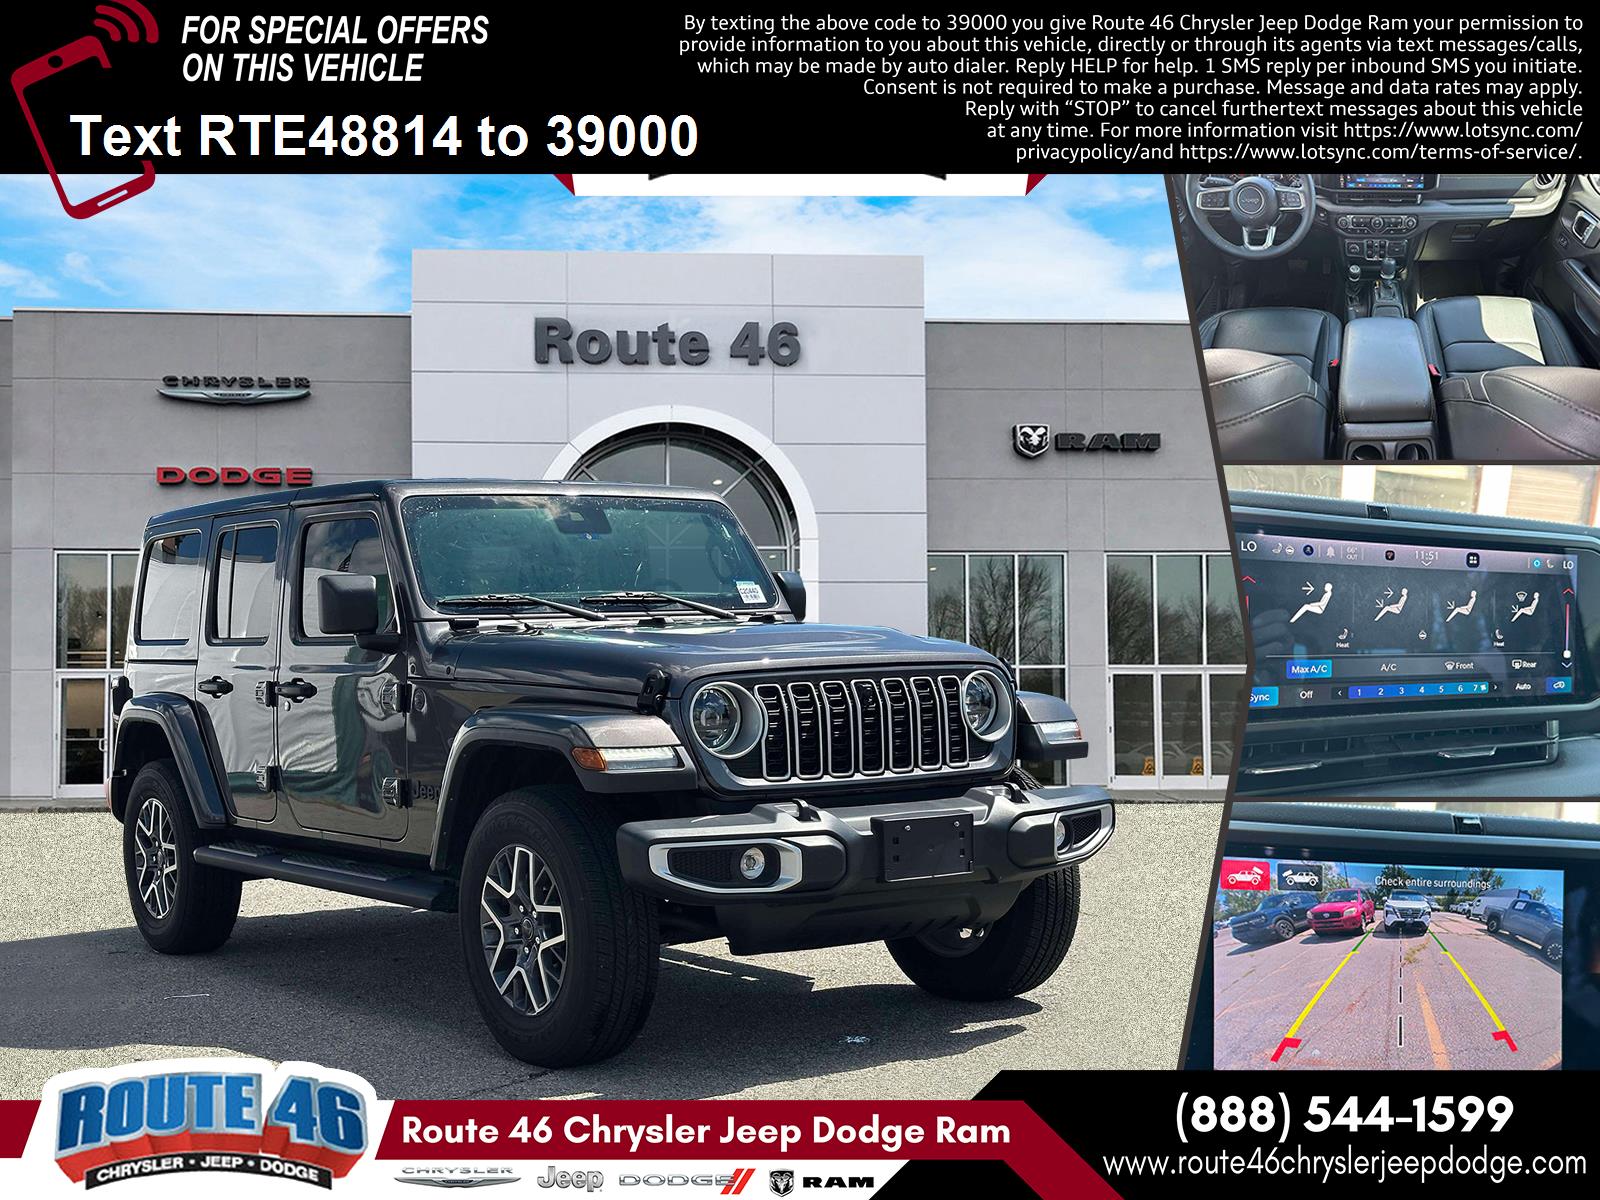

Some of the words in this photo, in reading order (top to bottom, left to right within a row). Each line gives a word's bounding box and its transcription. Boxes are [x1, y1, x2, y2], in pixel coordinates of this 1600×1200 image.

[534, 317, 711, 366] Route
[730, 322, 801, 367] 46
[162, 375, 311, 388] CHRYSLER
[1054, 432, 1162, 452] RAM
[156, 466, 313, 486] DODGE
[1241, 541, 1257, 552] LO
[1415, 550, 1439, 560] 11:51
[1562, 560, 1574, 570] LO
[1291, 665, 1309, 674] Max
[1310, 664, 1328, 674] A/C
[1380, 663, 1397, 672] A/C
[1455, 661, 1474, 670] Front
[1522, 660, 1537, 669] Rear
[1378, 688, 1384, 696] 2
[1399, 686, 1405, 695] 3
[1419, 686, 1425, 694] 4
[1439, 685, 1444, 693] 5
[1458, 684, 1463, 692] 6
[1515, 681, 1532, 690] Auto
[1299, 690, 1314, 700] Off
[1375, 876, 1405, 886] Check
[1405, 876, 1432, 887] entire
[1433, 879, 1491, 890] surroundings
